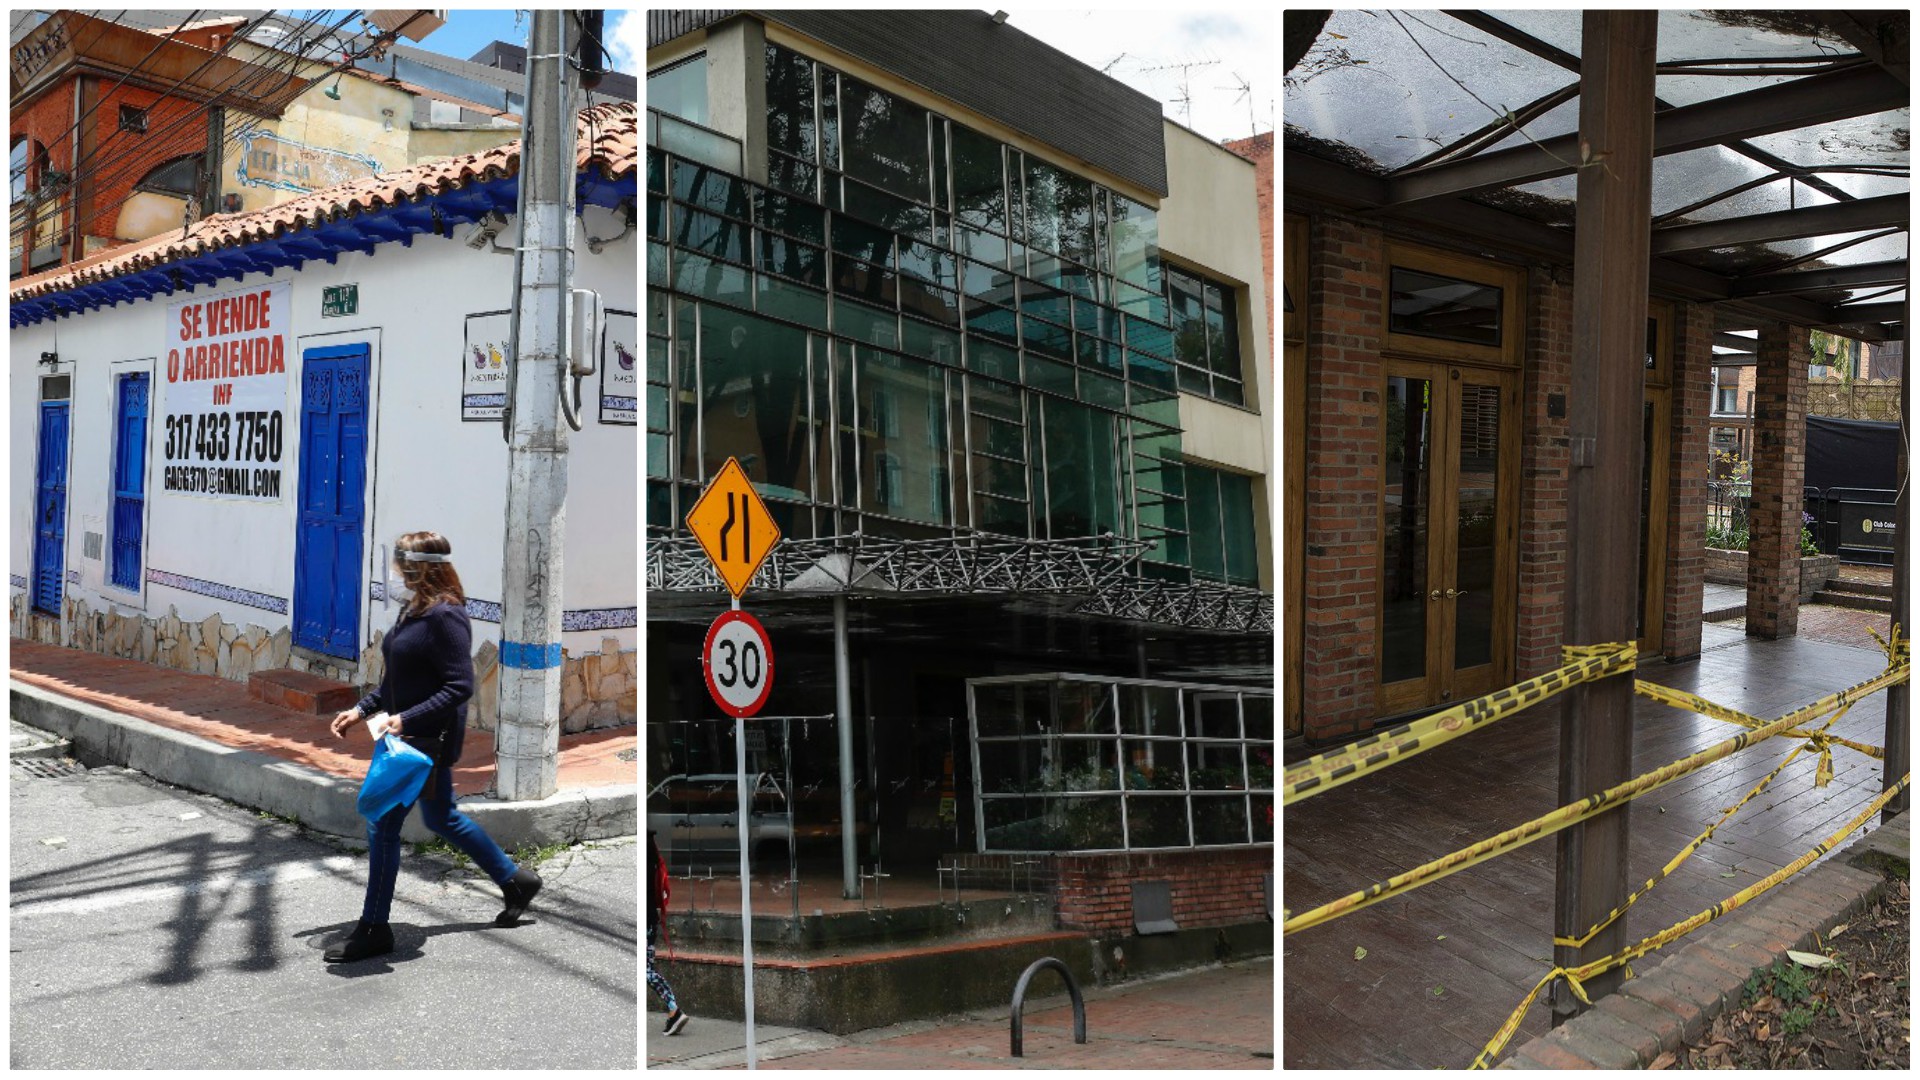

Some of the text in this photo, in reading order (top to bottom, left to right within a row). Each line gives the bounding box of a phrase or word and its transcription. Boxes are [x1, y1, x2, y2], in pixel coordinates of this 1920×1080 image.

[180, 290, 272, 341] SE VENDE
[167, 334, 285, 384] O ARRIENDA
[213, 383, 233, 406] INF
[165, 409, 283, 463] 317 433 7750
[1873, 520, 1884, 528] Club
[718, 638, 761, 689] 30
[1752, 720, 1786, 742] PELIGRO
[1786, 714, 1798, 727] NO
